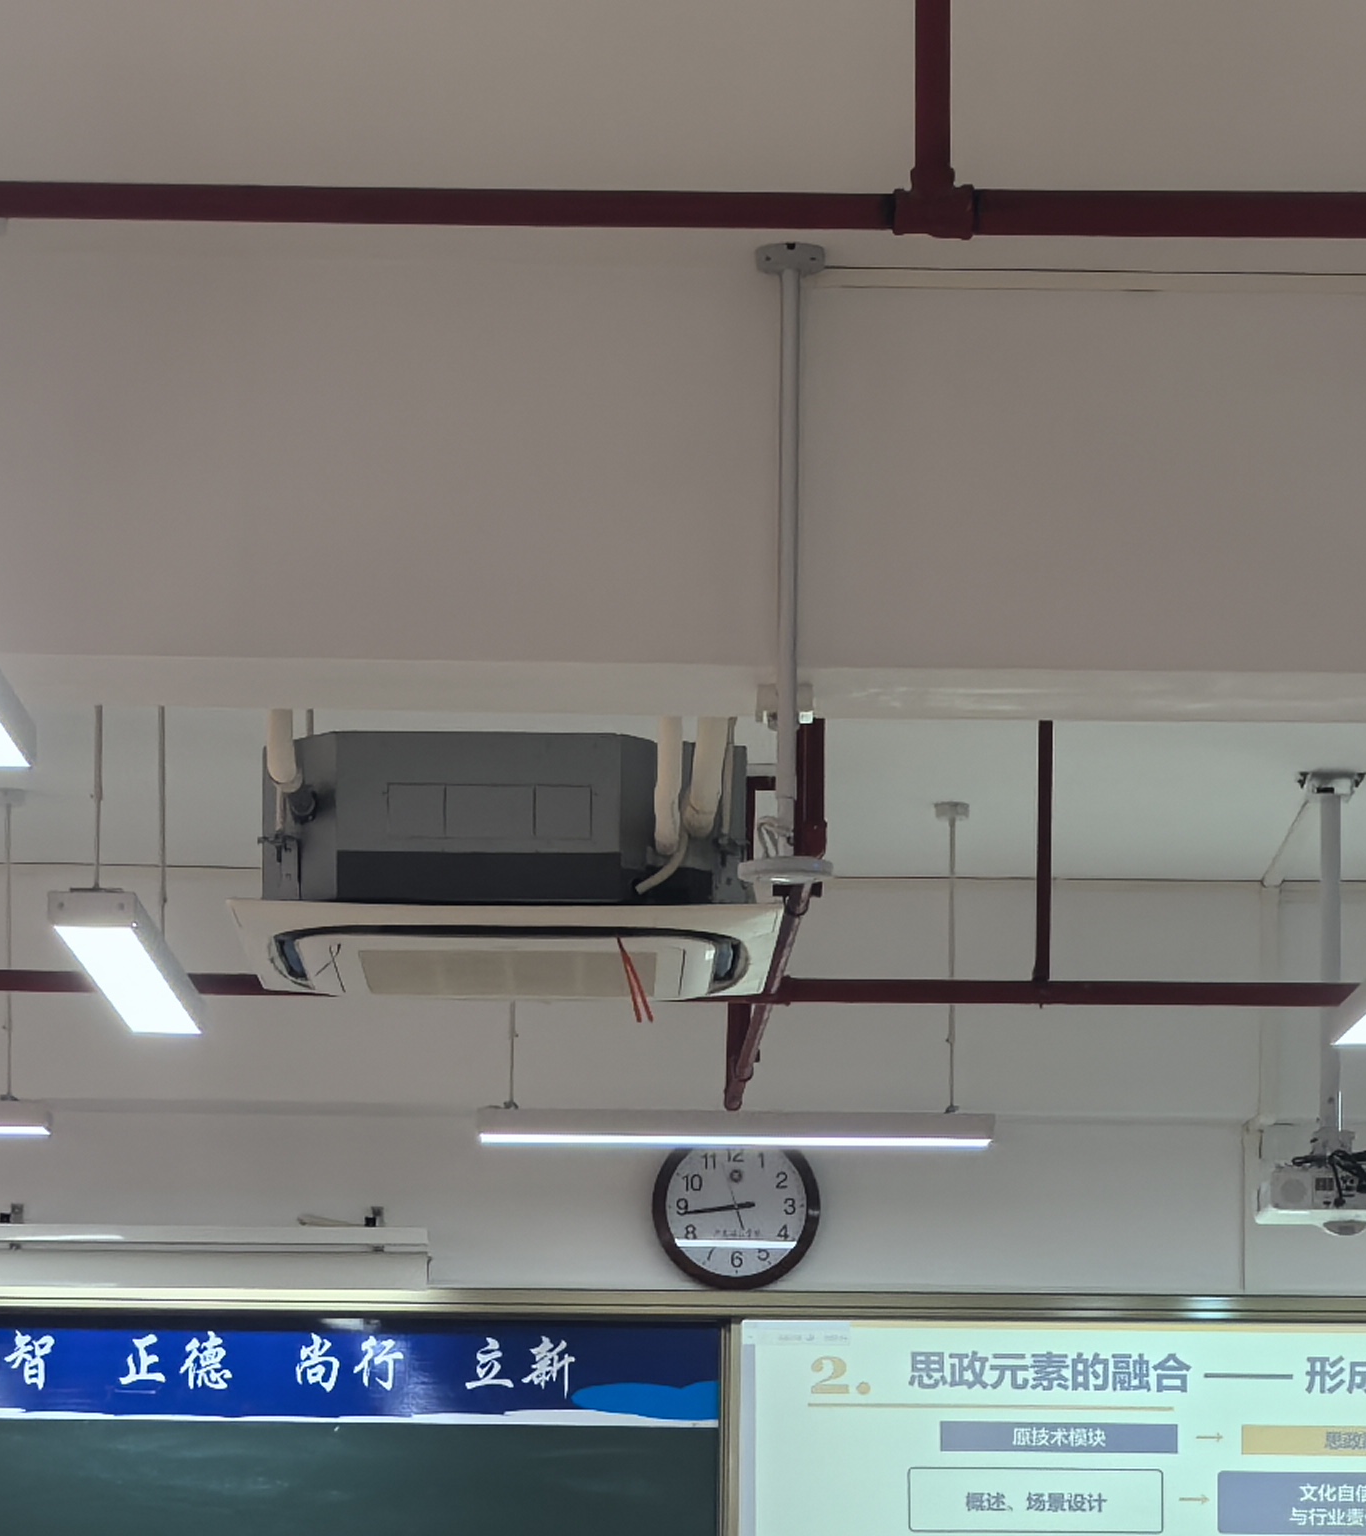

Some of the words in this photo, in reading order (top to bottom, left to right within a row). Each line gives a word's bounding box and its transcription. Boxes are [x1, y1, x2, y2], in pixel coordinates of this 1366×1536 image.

[702, 1153, 716, 1169] 11
[758, 1152, 765, 1168] 1
[683, 1174, 703, 1191] 10
[776, 1172, 788, 1189] 2
[676, 1198, 688, 1216] 9
[783, 1198, 796, 1215] 3
[685, 1224, 697, 1240] 8
[777, 1225, 789, 1240] 4
[731, 1251, 743, 1268] 6
[119, 1331, 233, 1390] 正德
[295, 1332, 404, 1393] 尚行
[465, 1336, 576, 1400] 立新
[810, 1356, 871, 1396] 2.
[908, 1350, 1193, 1394] 思政元素的融合
[1012, 1427, 1107, 1448] 原技术模块
[965, 1491, 1107, 1513] 概述、场景设计
